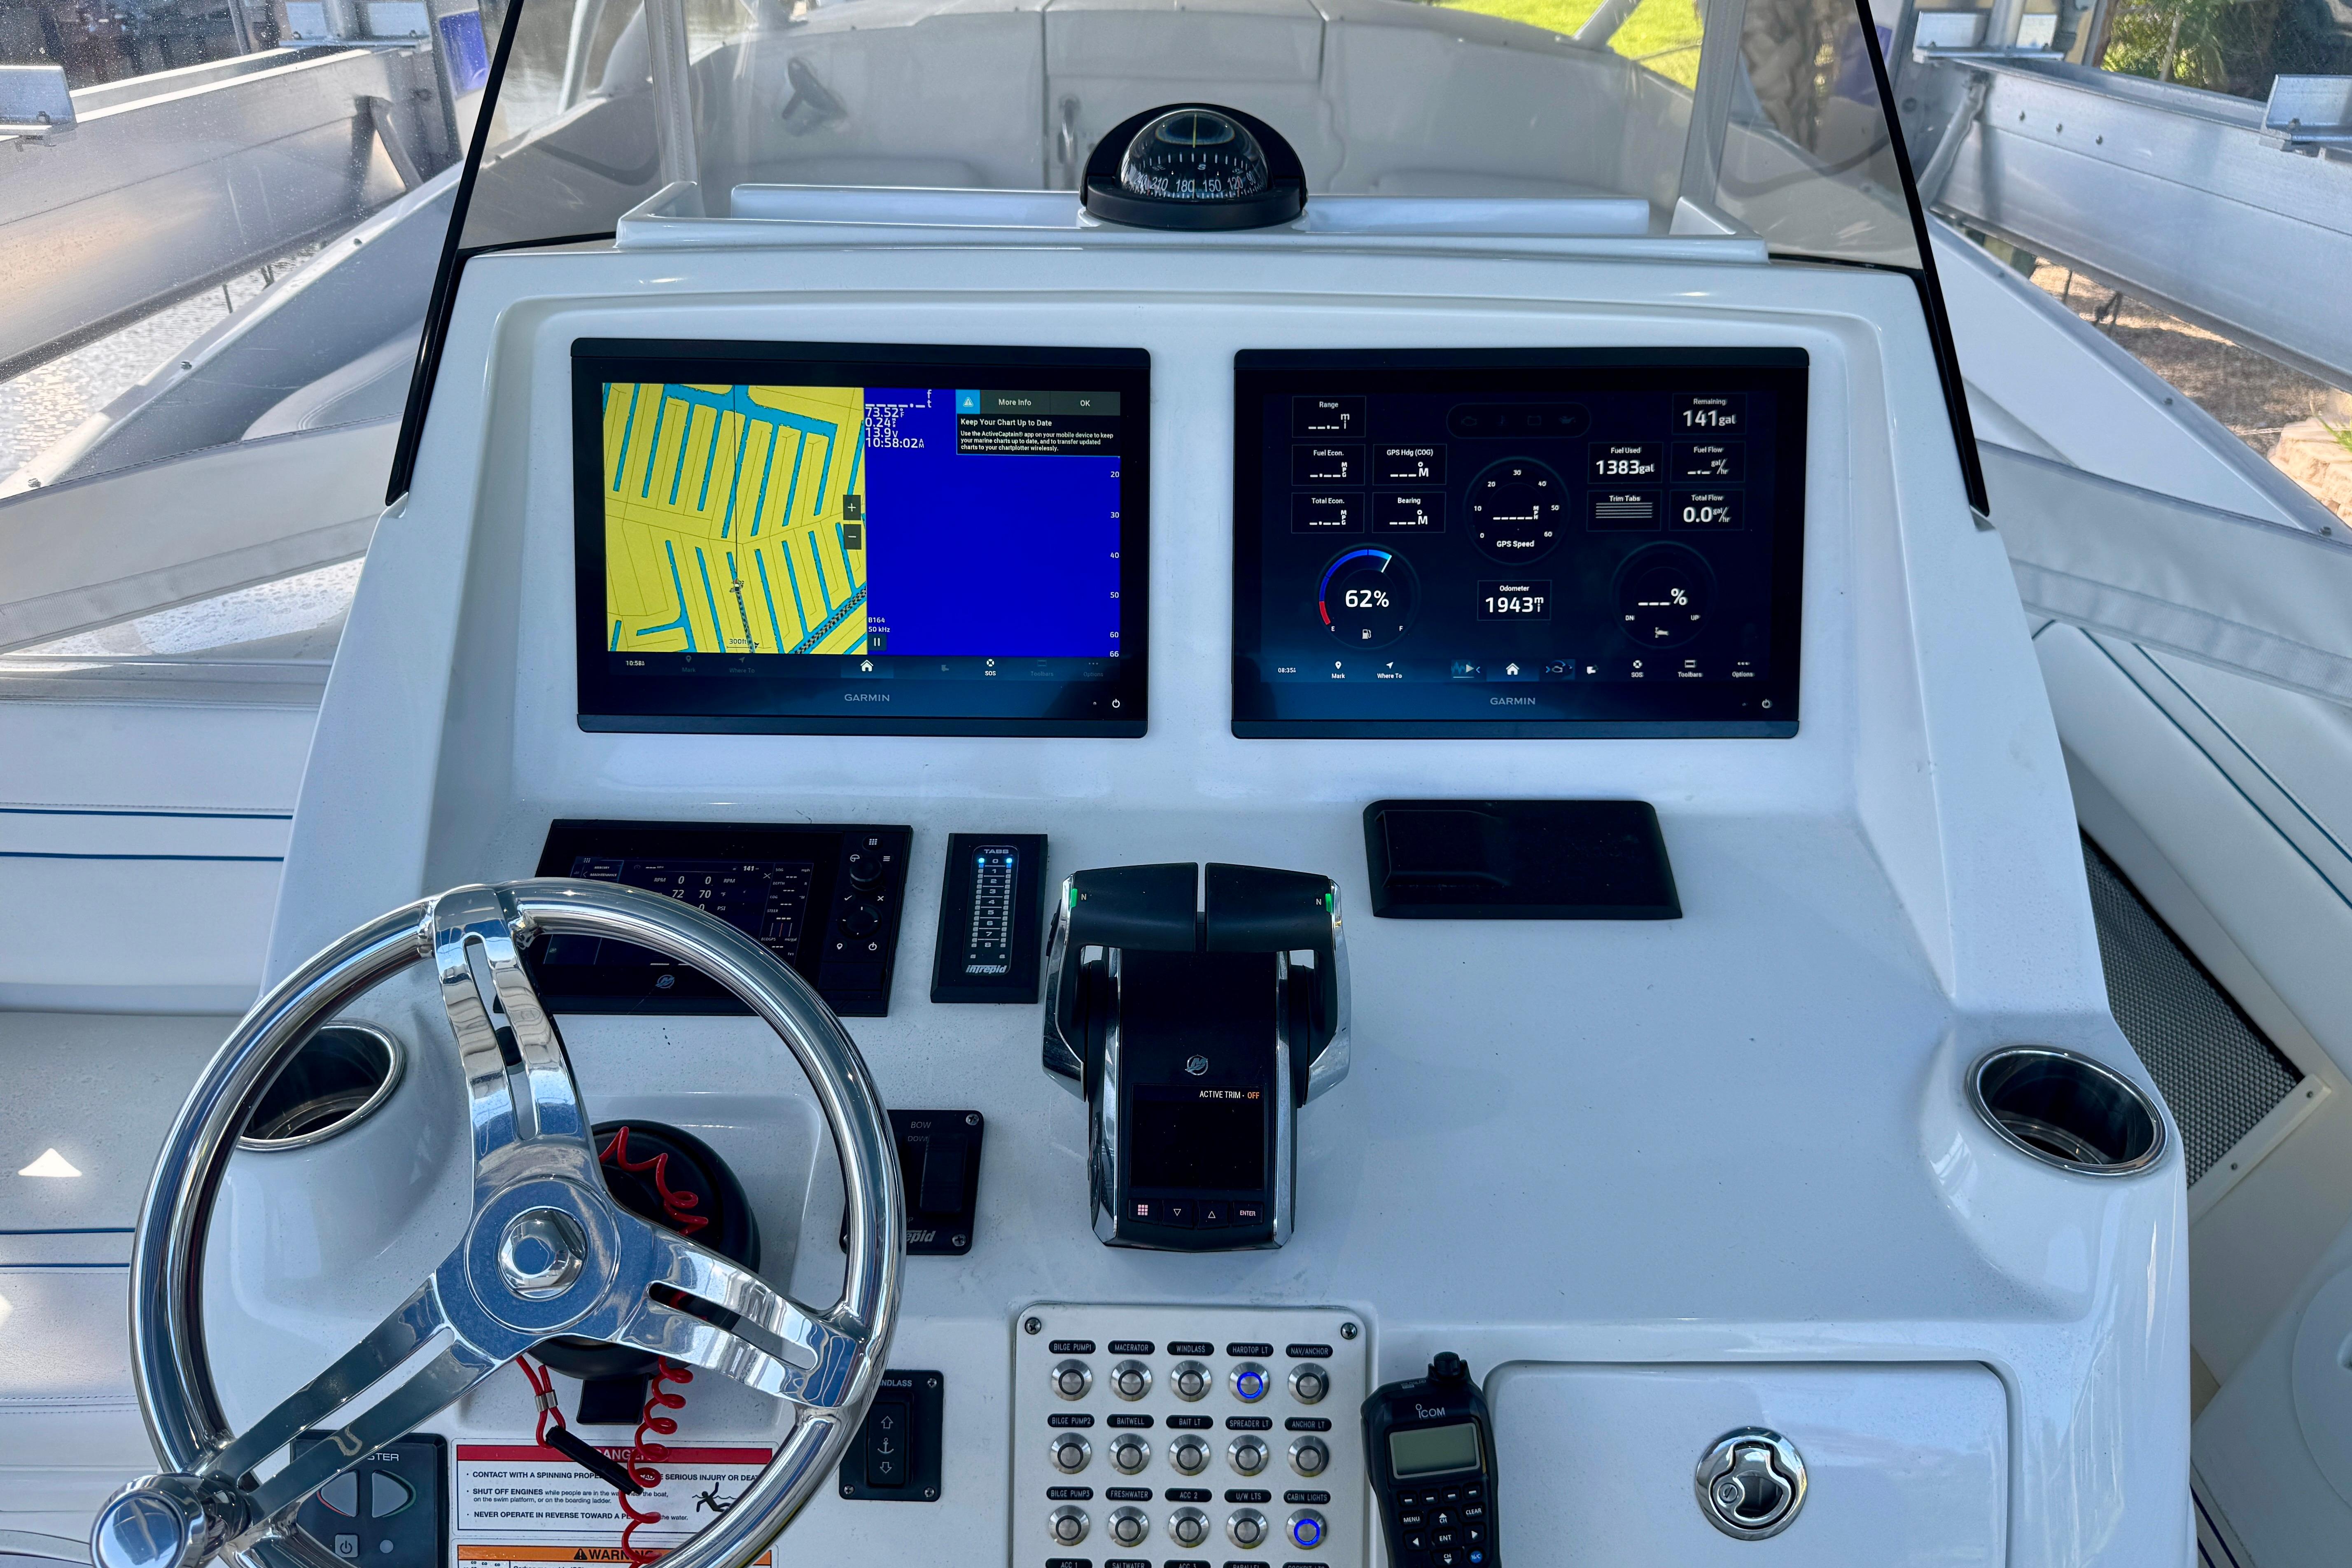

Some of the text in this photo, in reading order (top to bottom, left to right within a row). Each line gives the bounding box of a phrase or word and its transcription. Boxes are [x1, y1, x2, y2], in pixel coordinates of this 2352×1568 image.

[1150, 177, 1168, 191] 210
[1176, 180, 1194, 192] 180
[1203, 180, 1221, 192] 150
[1345, 590, 1389, 607] 62%
